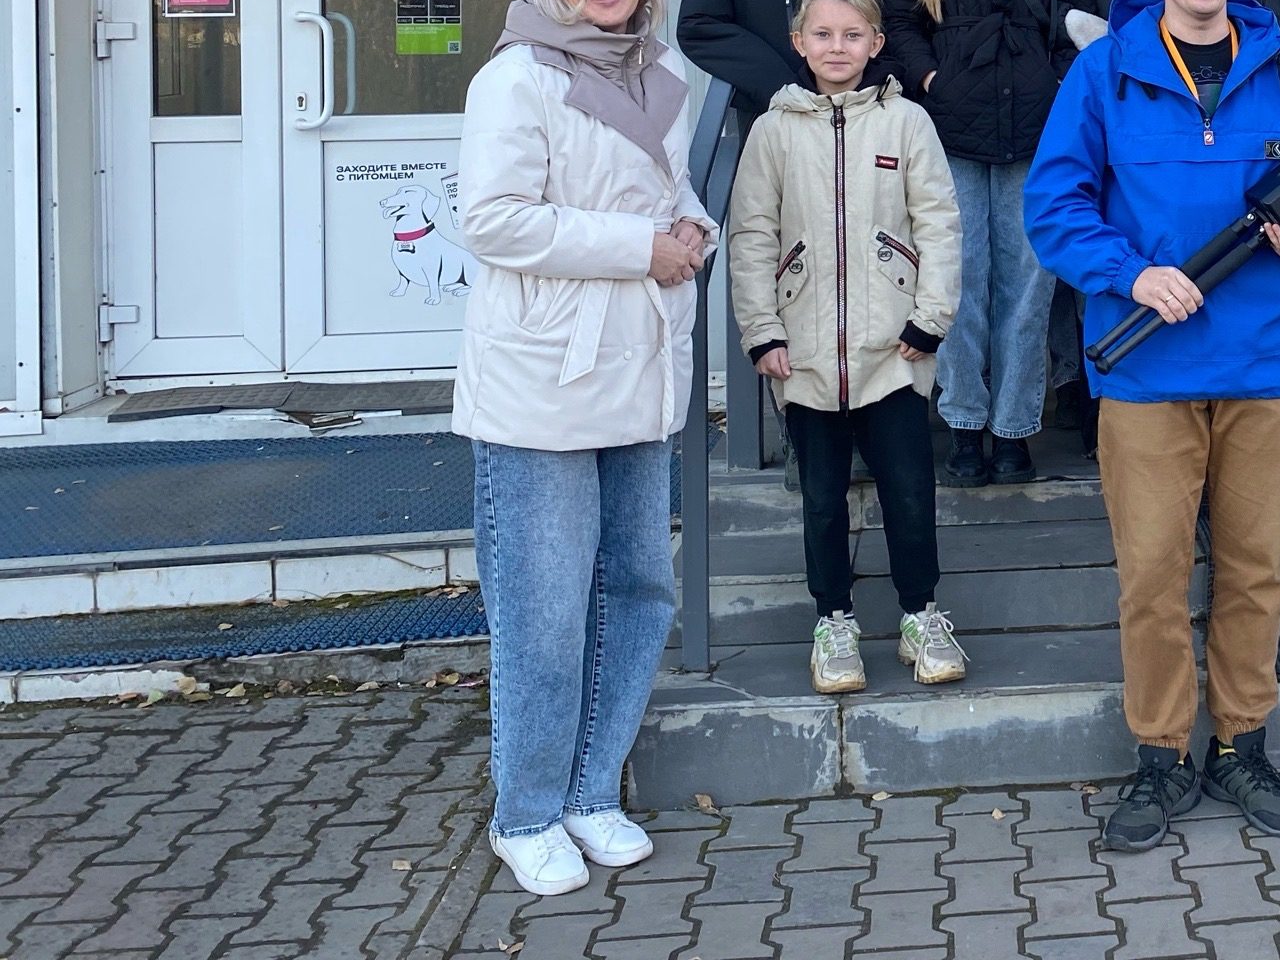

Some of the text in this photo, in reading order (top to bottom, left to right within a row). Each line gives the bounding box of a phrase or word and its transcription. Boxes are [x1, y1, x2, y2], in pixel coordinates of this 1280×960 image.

[336, 162, 447, 173] ЗАХОДИТЕ ВМЕСТЕ
[348, 172, 414, 181] ПИТОМЦЕМ
